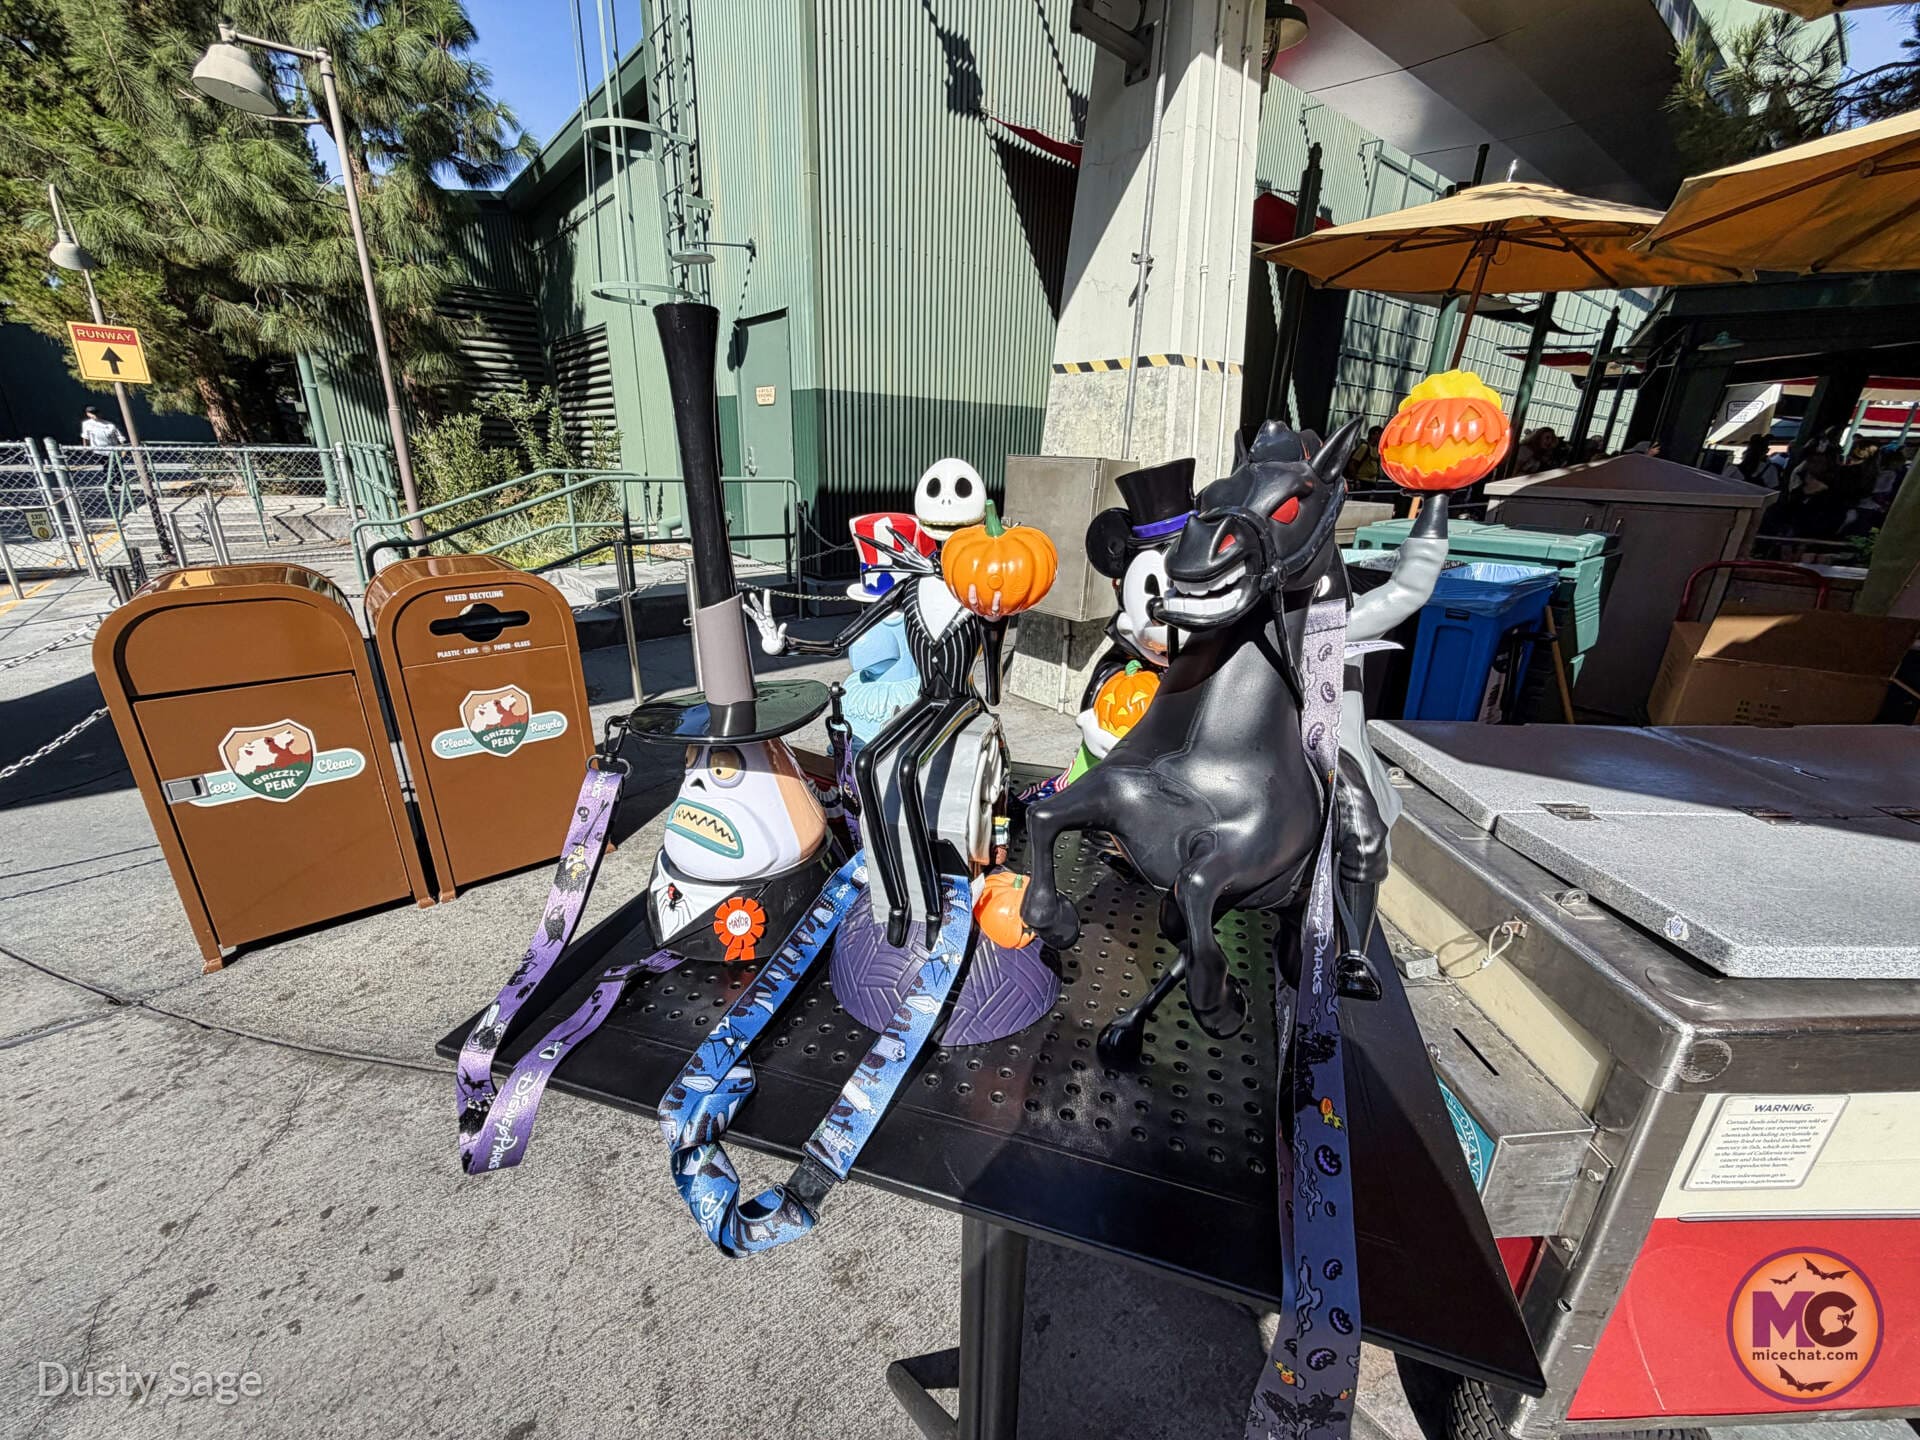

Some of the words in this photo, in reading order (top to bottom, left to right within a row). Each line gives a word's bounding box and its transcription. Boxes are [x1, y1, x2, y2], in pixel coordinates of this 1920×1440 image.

[76, 328, 131, 341] RUNWAY
[444, 593, 468, 603] MIXED
[469, 590, 504, 601] RECYCLING
[436, 650, 460, 659] PLASTIC
[439, 737, 475, 751] Please
[529, 718, 563, 734] Recycle
[482, 728, 522, 742] GRIZZLY
[491, 736, 516, 749] PEAK
[316, 757, 356, 774] Clean
[252, 769, 304, 786] GRIZZLY
[265, 777, 297, 793] PEAK
[728, 911, 750, 929] MAYOR
[1754, 1103, 1816, 1112] WARNING:
[1460, 1117, 1482, 1187] ORANG
